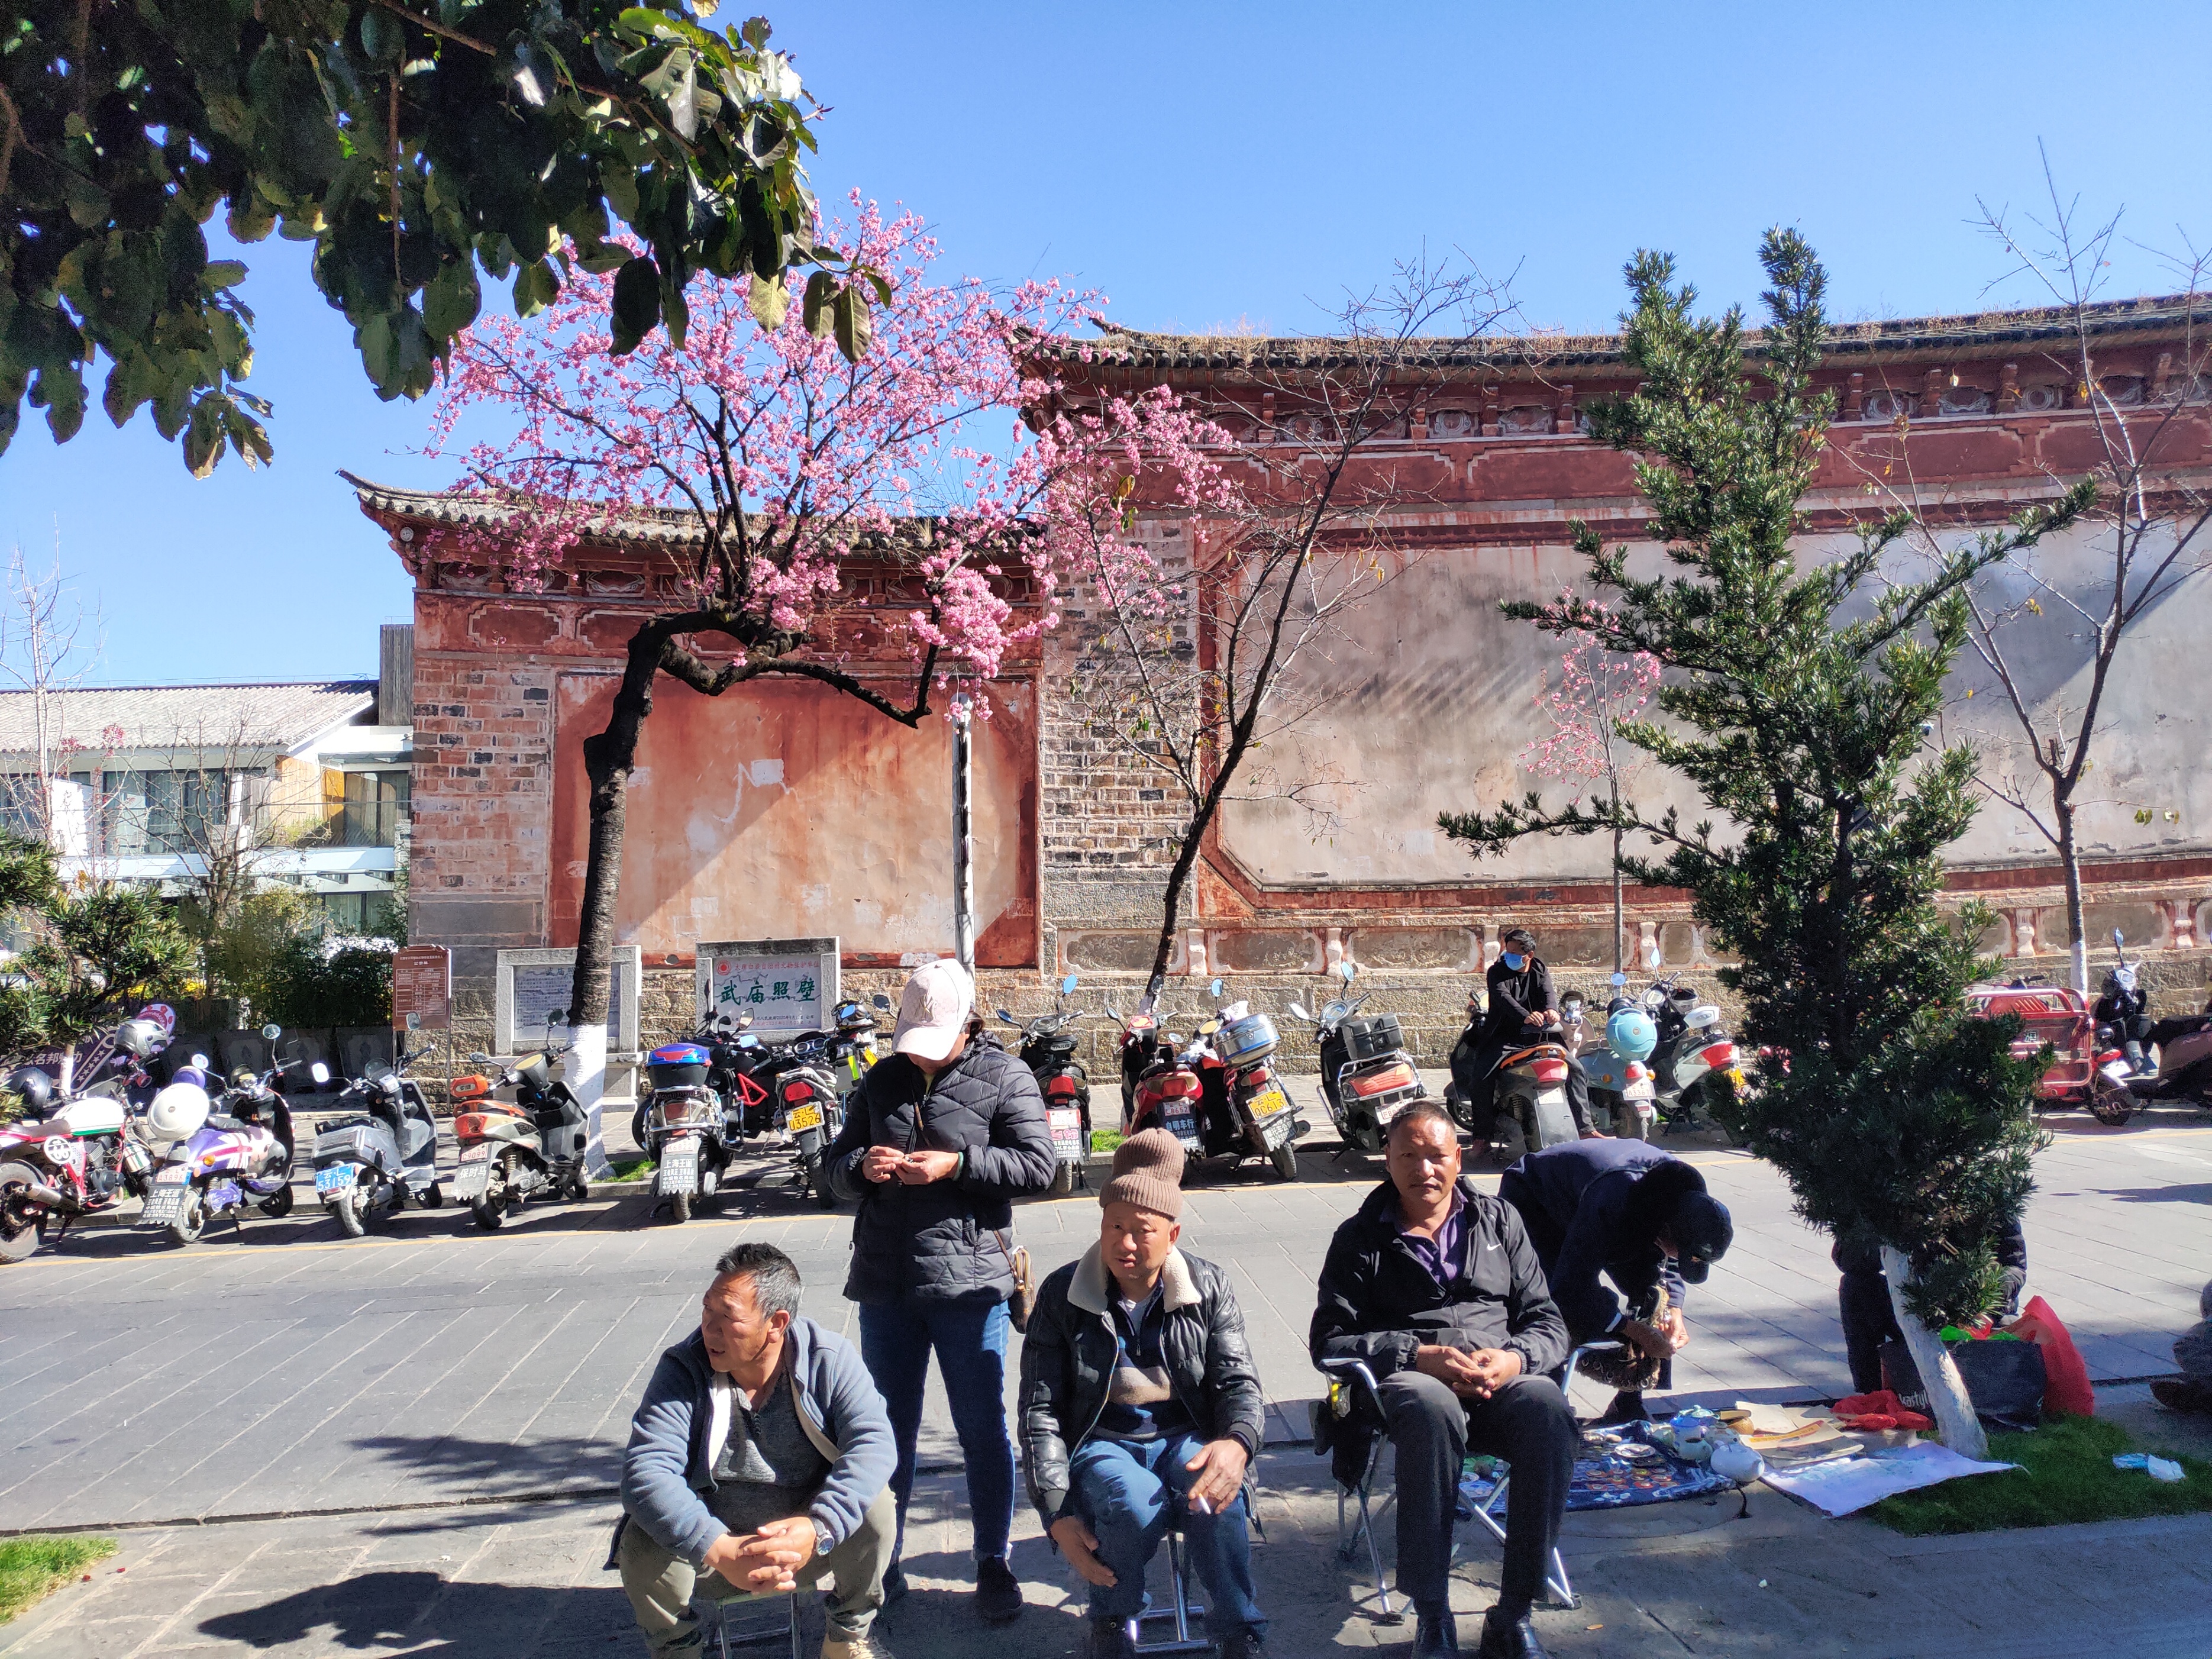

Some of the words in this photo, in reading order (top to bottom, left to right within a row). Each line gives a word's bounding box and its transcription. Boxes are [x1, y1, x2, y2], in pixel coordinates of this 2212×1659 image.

[720, 977, 815, 1006] 武庙照壁
[789, 1113, 821, 1131] U3526
[460, 1166, 487, 1179] 保时马
[318, 1174, 351, 1190] 53159
